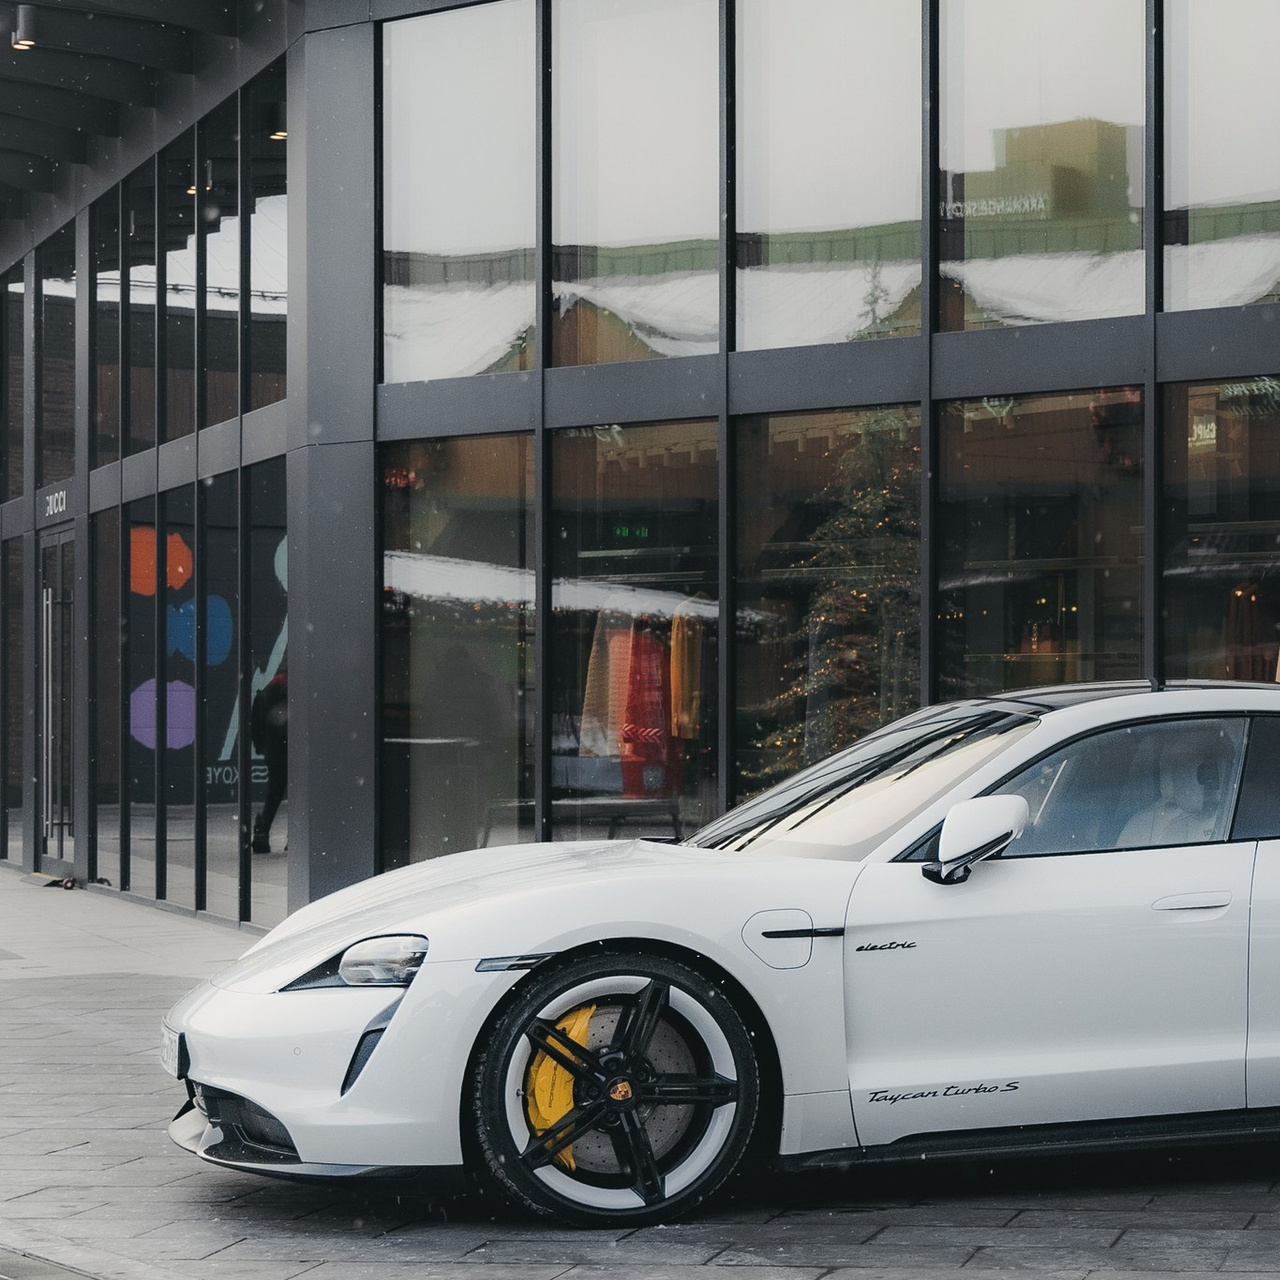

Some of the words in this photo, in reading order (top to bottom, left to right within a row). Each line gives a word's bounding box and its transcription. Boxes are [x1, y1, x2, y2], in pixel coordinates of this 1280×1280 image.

[855, 941, 917, 952] electric
[868, 1090, 938, 1105] Taycan
[943, 1083, 999, 1097] turbo
[1000, 1081, 1020, 1093] S
